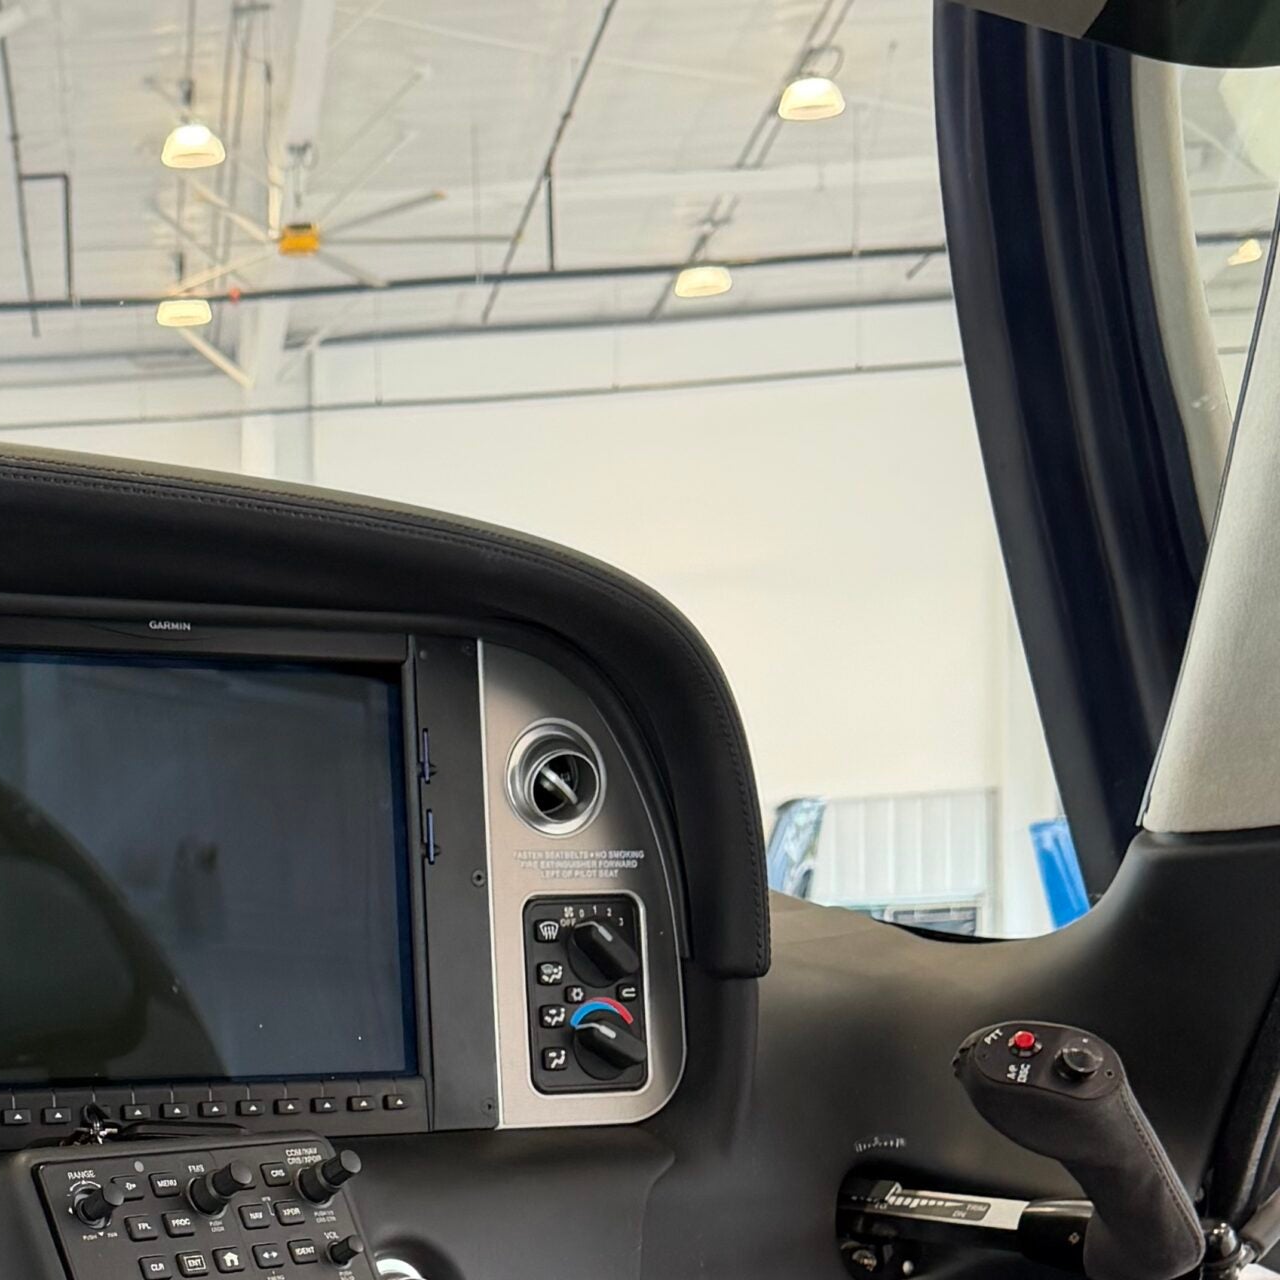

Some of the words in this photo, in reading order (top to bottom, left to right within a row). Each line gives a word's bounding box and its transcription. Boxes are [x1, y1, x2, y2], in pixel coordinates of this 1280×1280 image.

[148, 620, 191, 631] GARMIN
[595, 850, 608, 860] NO
[608, 850, 645, 860] SMOKING
[599, 860, 638, 869] FORWARD
[606, 907, 613, 917] 2
[983, 1028, 1003, 1045] PTT
[67, 1169, 96, 1180] RANGE
[188, 1164, 205, 1173] FMS
[271, 1169, 286, 1177] CRS
[156, 1179, 177, 1188] MENU
[138, 1222, 152, 1230] FPL
[171, 1218, 191, 1227] PROC
[324, 1231, 339, 1240] VOL
[150, 1263, 165, 1272] CLR
[187, 1258, 202, 1268] ENT
[295, 1246, 315, 1255] IDENT
